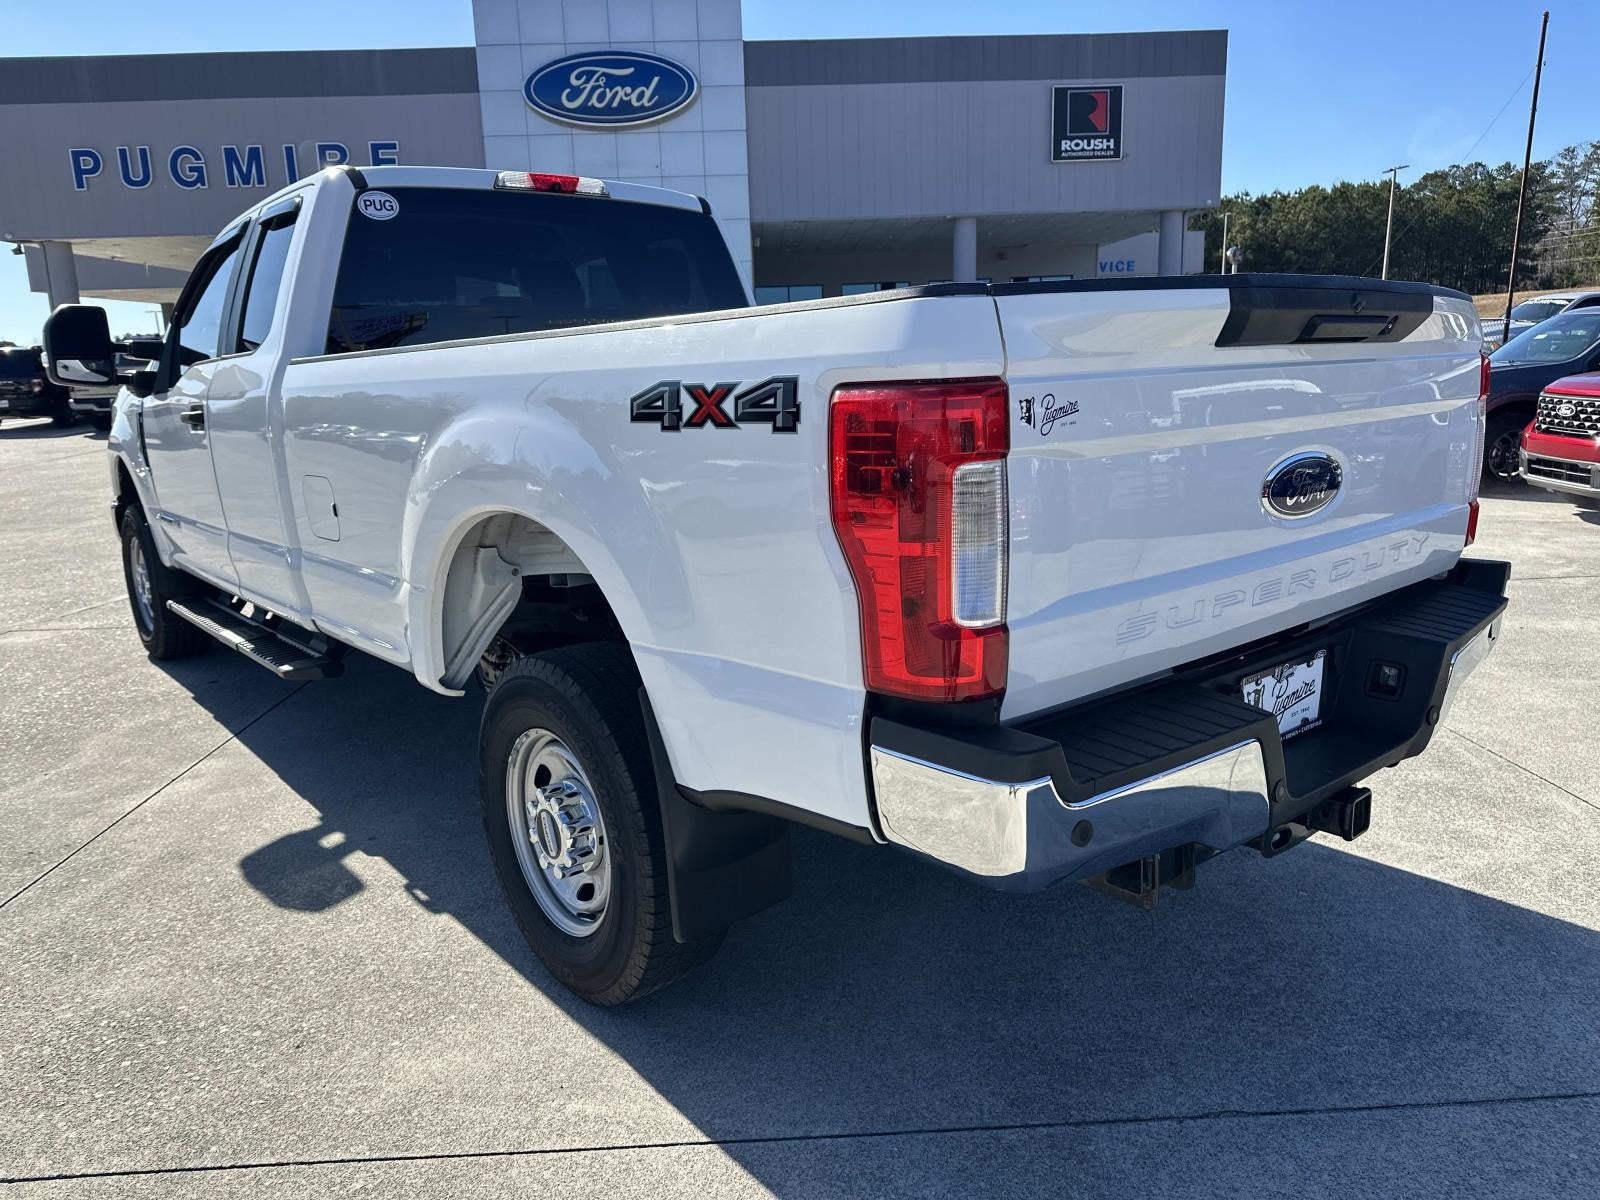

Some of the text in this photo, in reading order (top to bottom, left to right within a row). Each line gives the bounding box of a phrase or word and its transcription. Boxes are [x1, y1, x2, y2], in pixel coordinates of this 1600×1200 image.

[561, 66, 661, 109] Ford
[1061, 138, 1115, 151] ROUSH
[362, 199, 395, 211] PUG
[1040, 393, 1080, 436] Pugmire
[1284, 467, 1331, 506] Ford
[1115, 531, 1431, 646] SUPER DUTY
[1271, 678, 1317, 727] Pugmire
